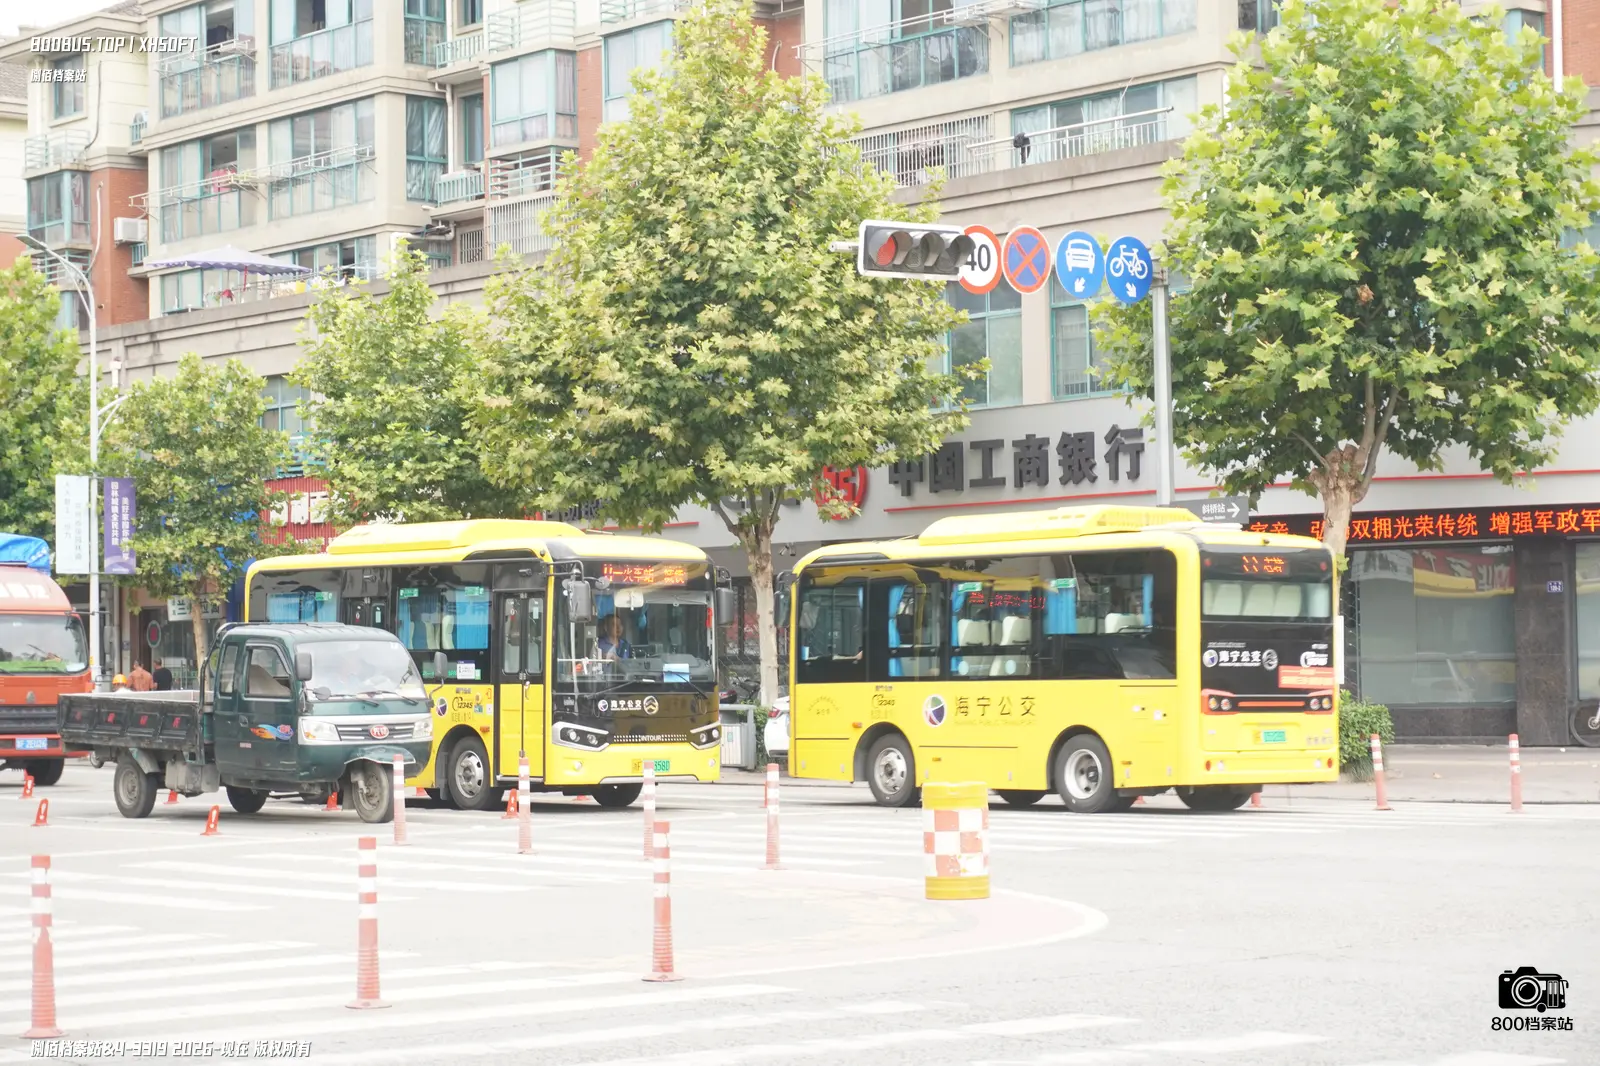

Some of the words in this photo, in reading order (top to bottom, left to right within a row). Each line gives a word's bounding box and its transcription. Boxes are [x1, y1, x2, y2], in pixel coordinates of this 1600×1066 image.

[966, 243, 992, 272] 40
[888, 423, 1146, 497] 中国工商银行
[1201, 503, 1226, 515] 斜桥站
[1310, 513, 1479, 542] 弘双拥光荣传统
[954, 696, 1036, 717] 海宁公交
